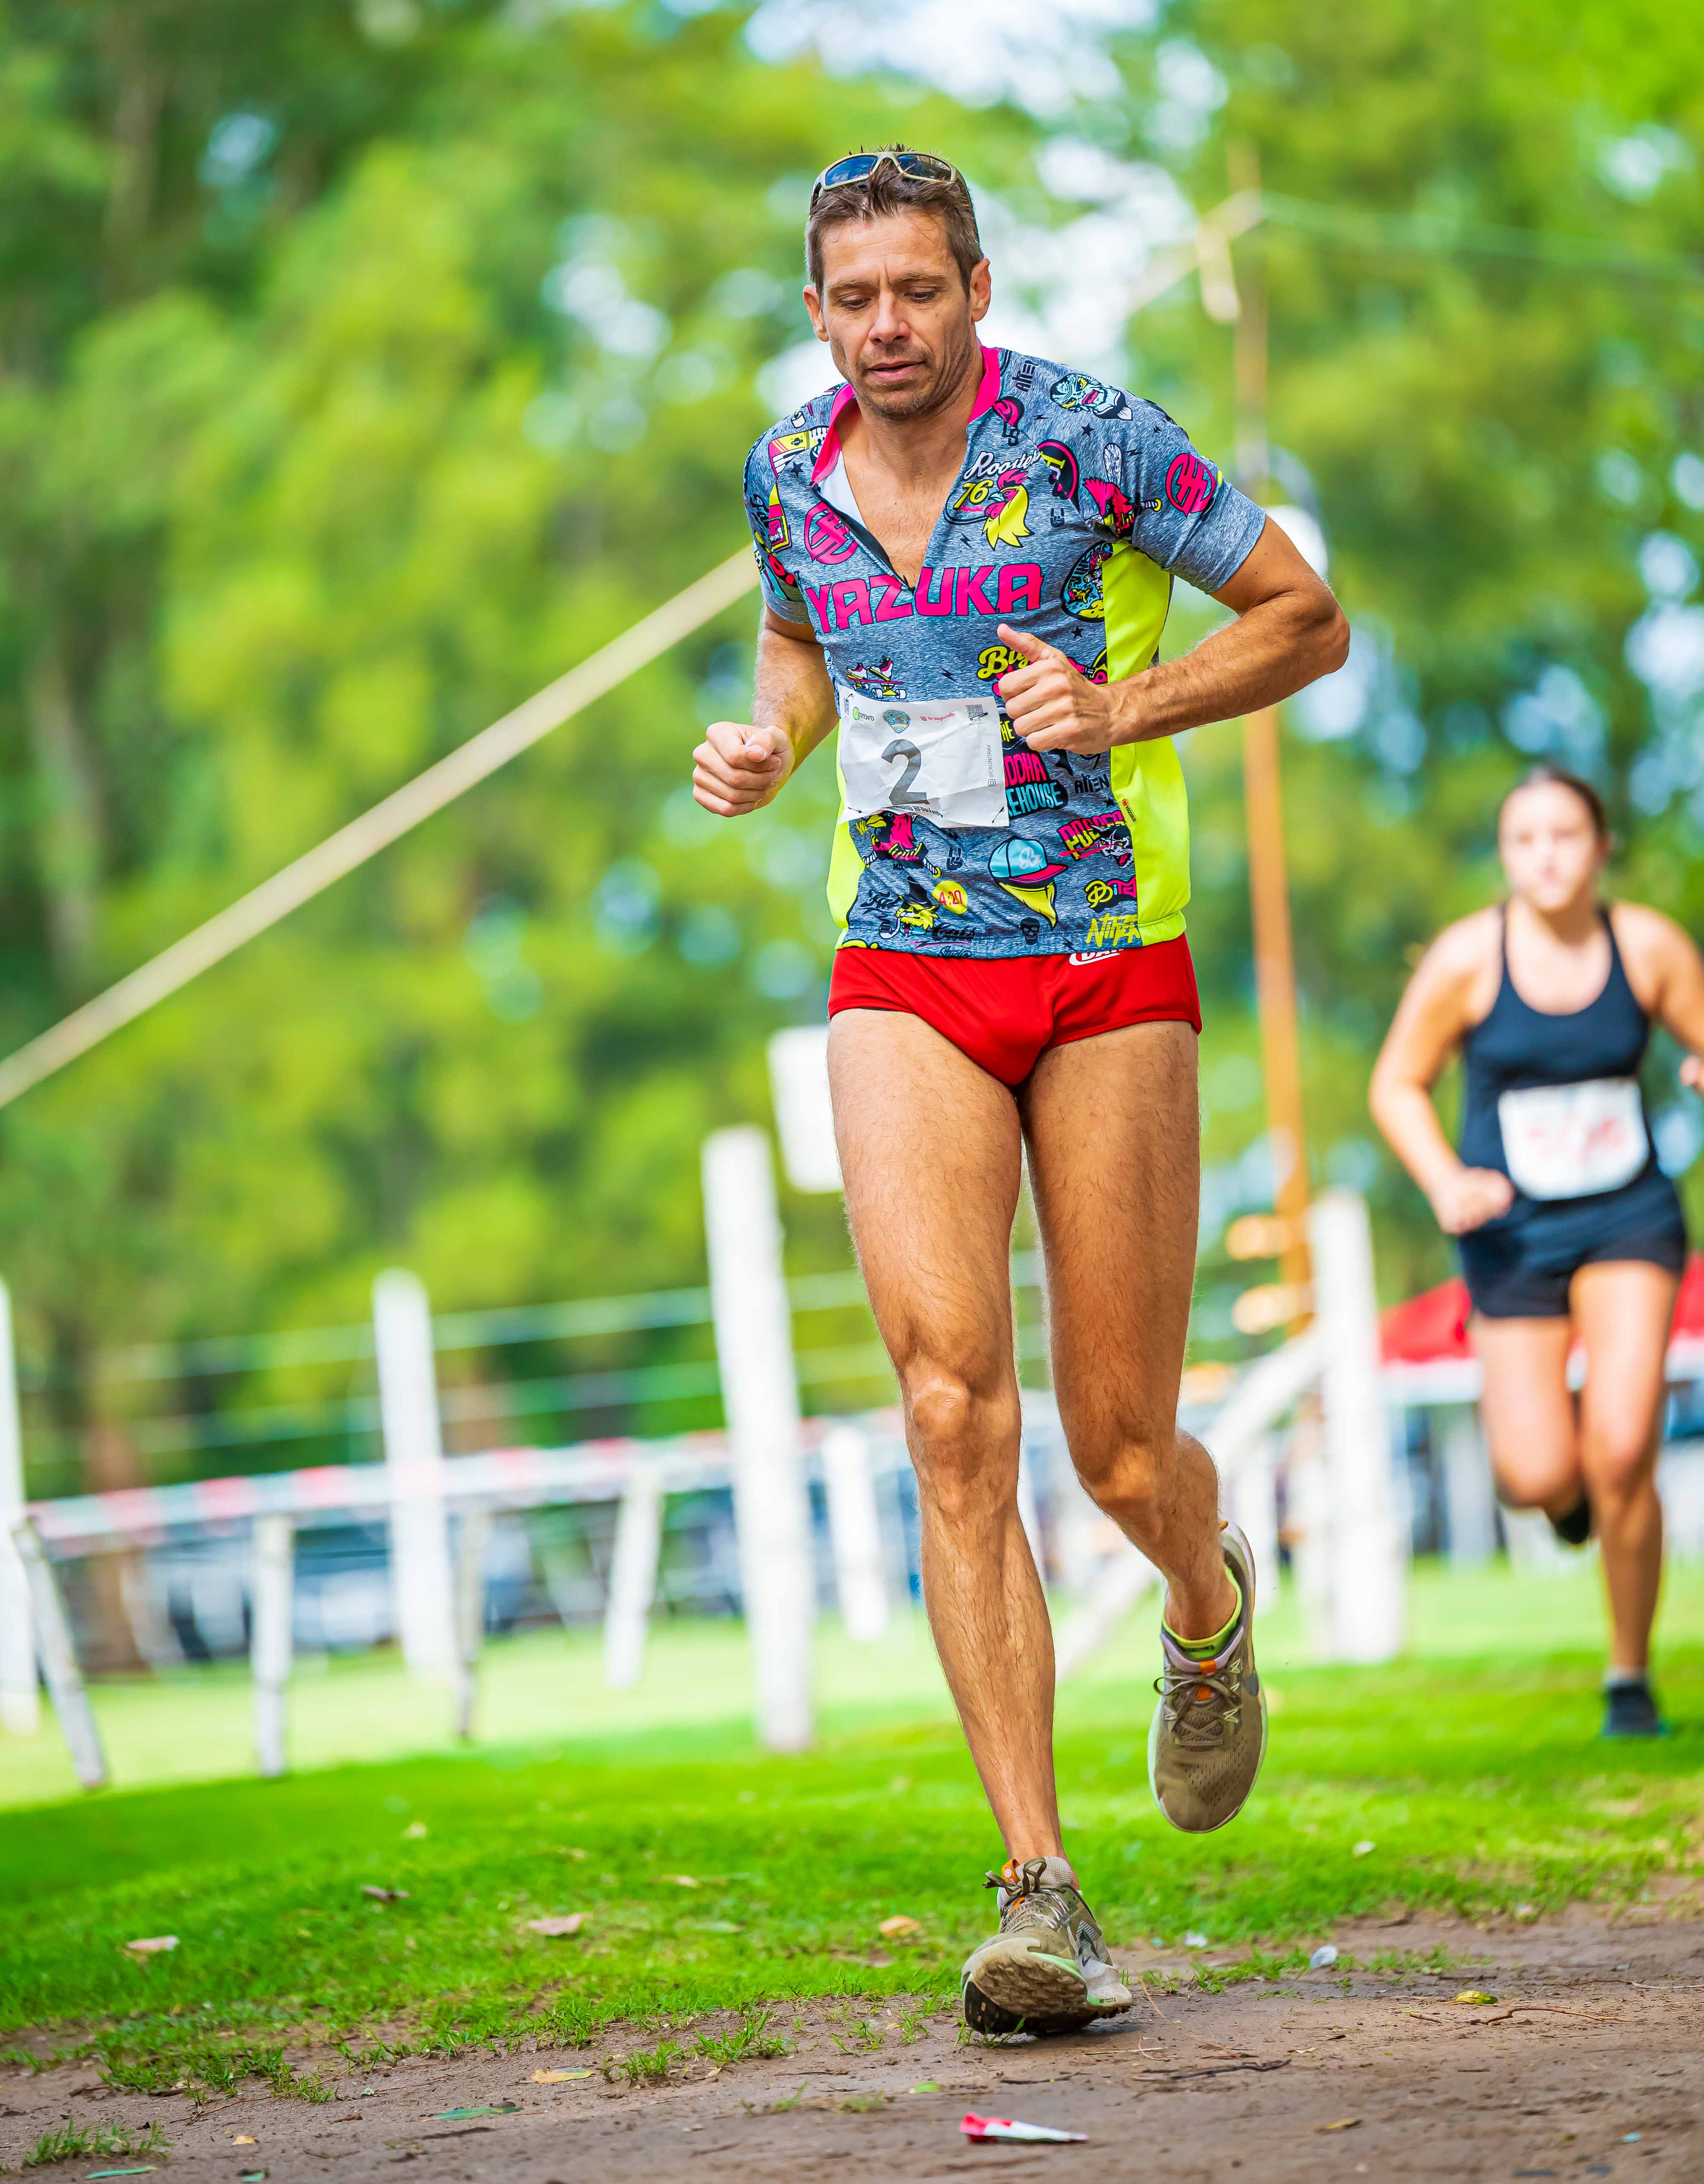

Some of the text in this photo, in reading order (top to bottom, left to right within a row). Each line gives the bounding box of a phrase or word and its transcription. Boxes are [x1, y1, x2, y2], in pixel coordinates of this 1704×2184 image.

[962, 450, 1041, 480] Rooster
[805, 562, 1045, 634] YAZUKA
[881, 739, 930, 805] 2
[1005, 782, 1064, 817] EHOUSE
[1125, 805, 1137, 823] YAZUKA
[939, 889, 963, 906] 4:20
